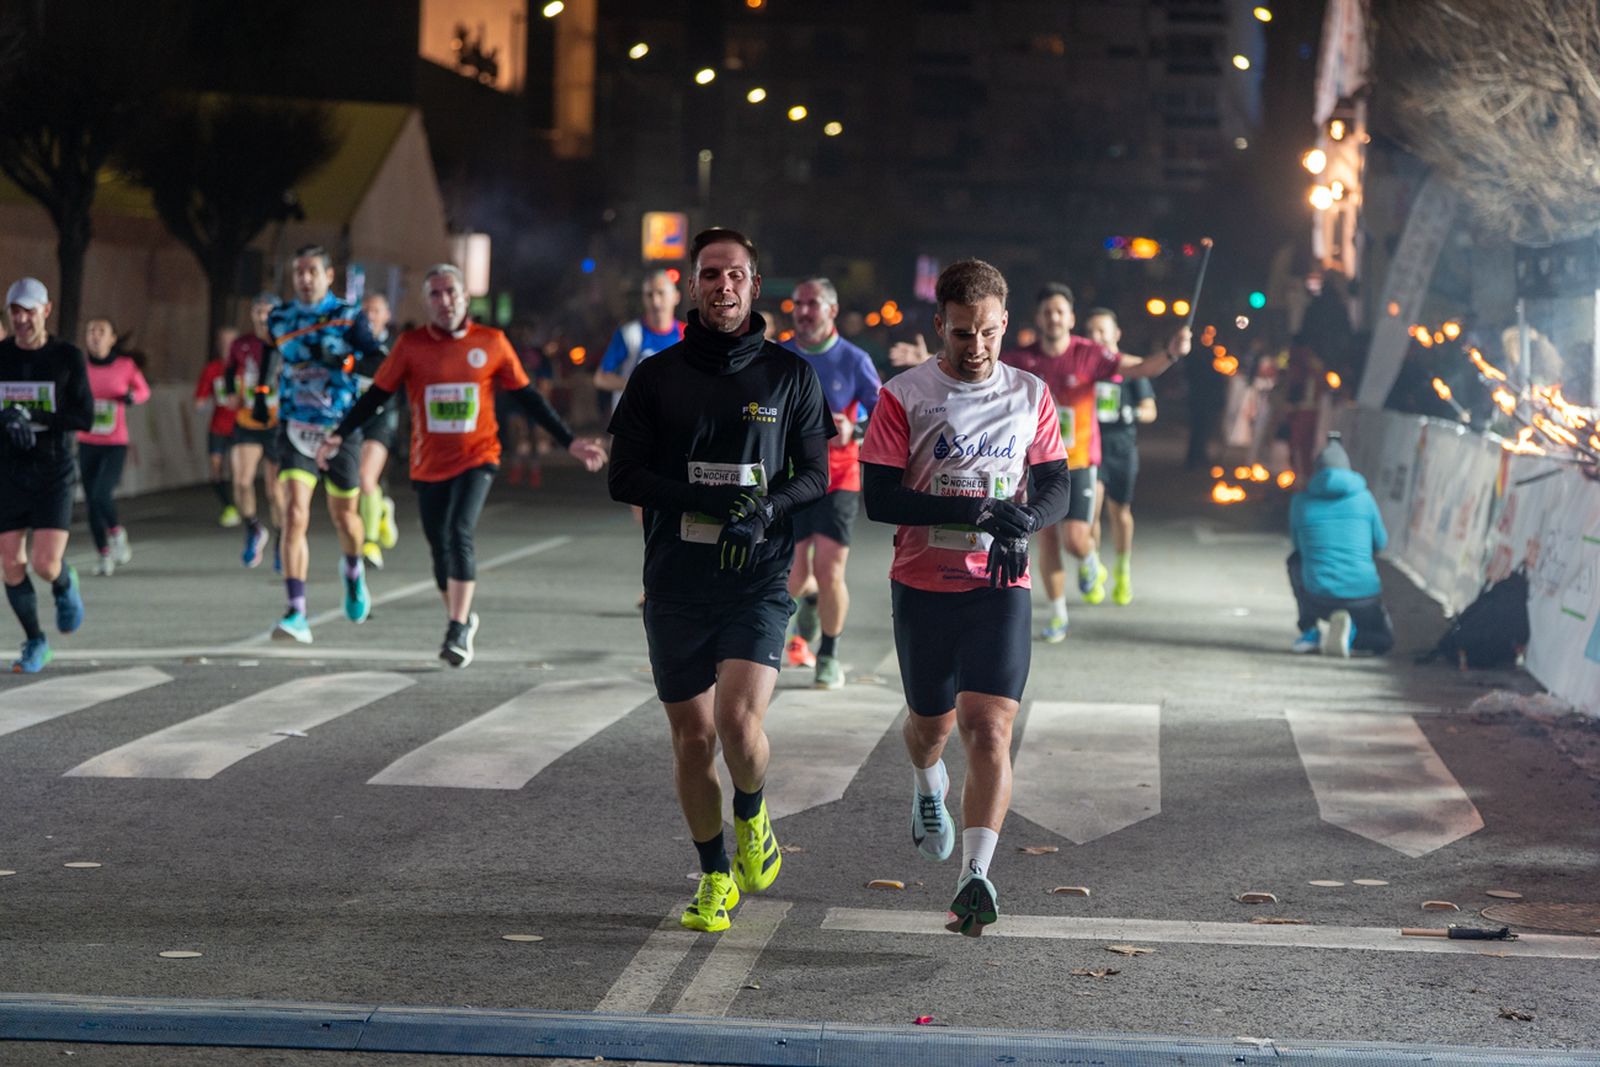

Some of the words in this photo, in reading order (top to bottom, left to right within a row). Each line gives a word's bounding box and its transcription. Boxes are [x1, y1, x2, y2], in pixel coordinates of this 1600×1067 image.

[742, 402, 778, 416] FOCUS
[948, 432, 1016, 459] Salud
[703, 471, 729, 481] NOCHE
[730, 473, 741, 482] DE
[950, 480, 976, 488] NOCHE
[978, 480, 989, 488] DE
[941, 488, 957, 497] SAN
